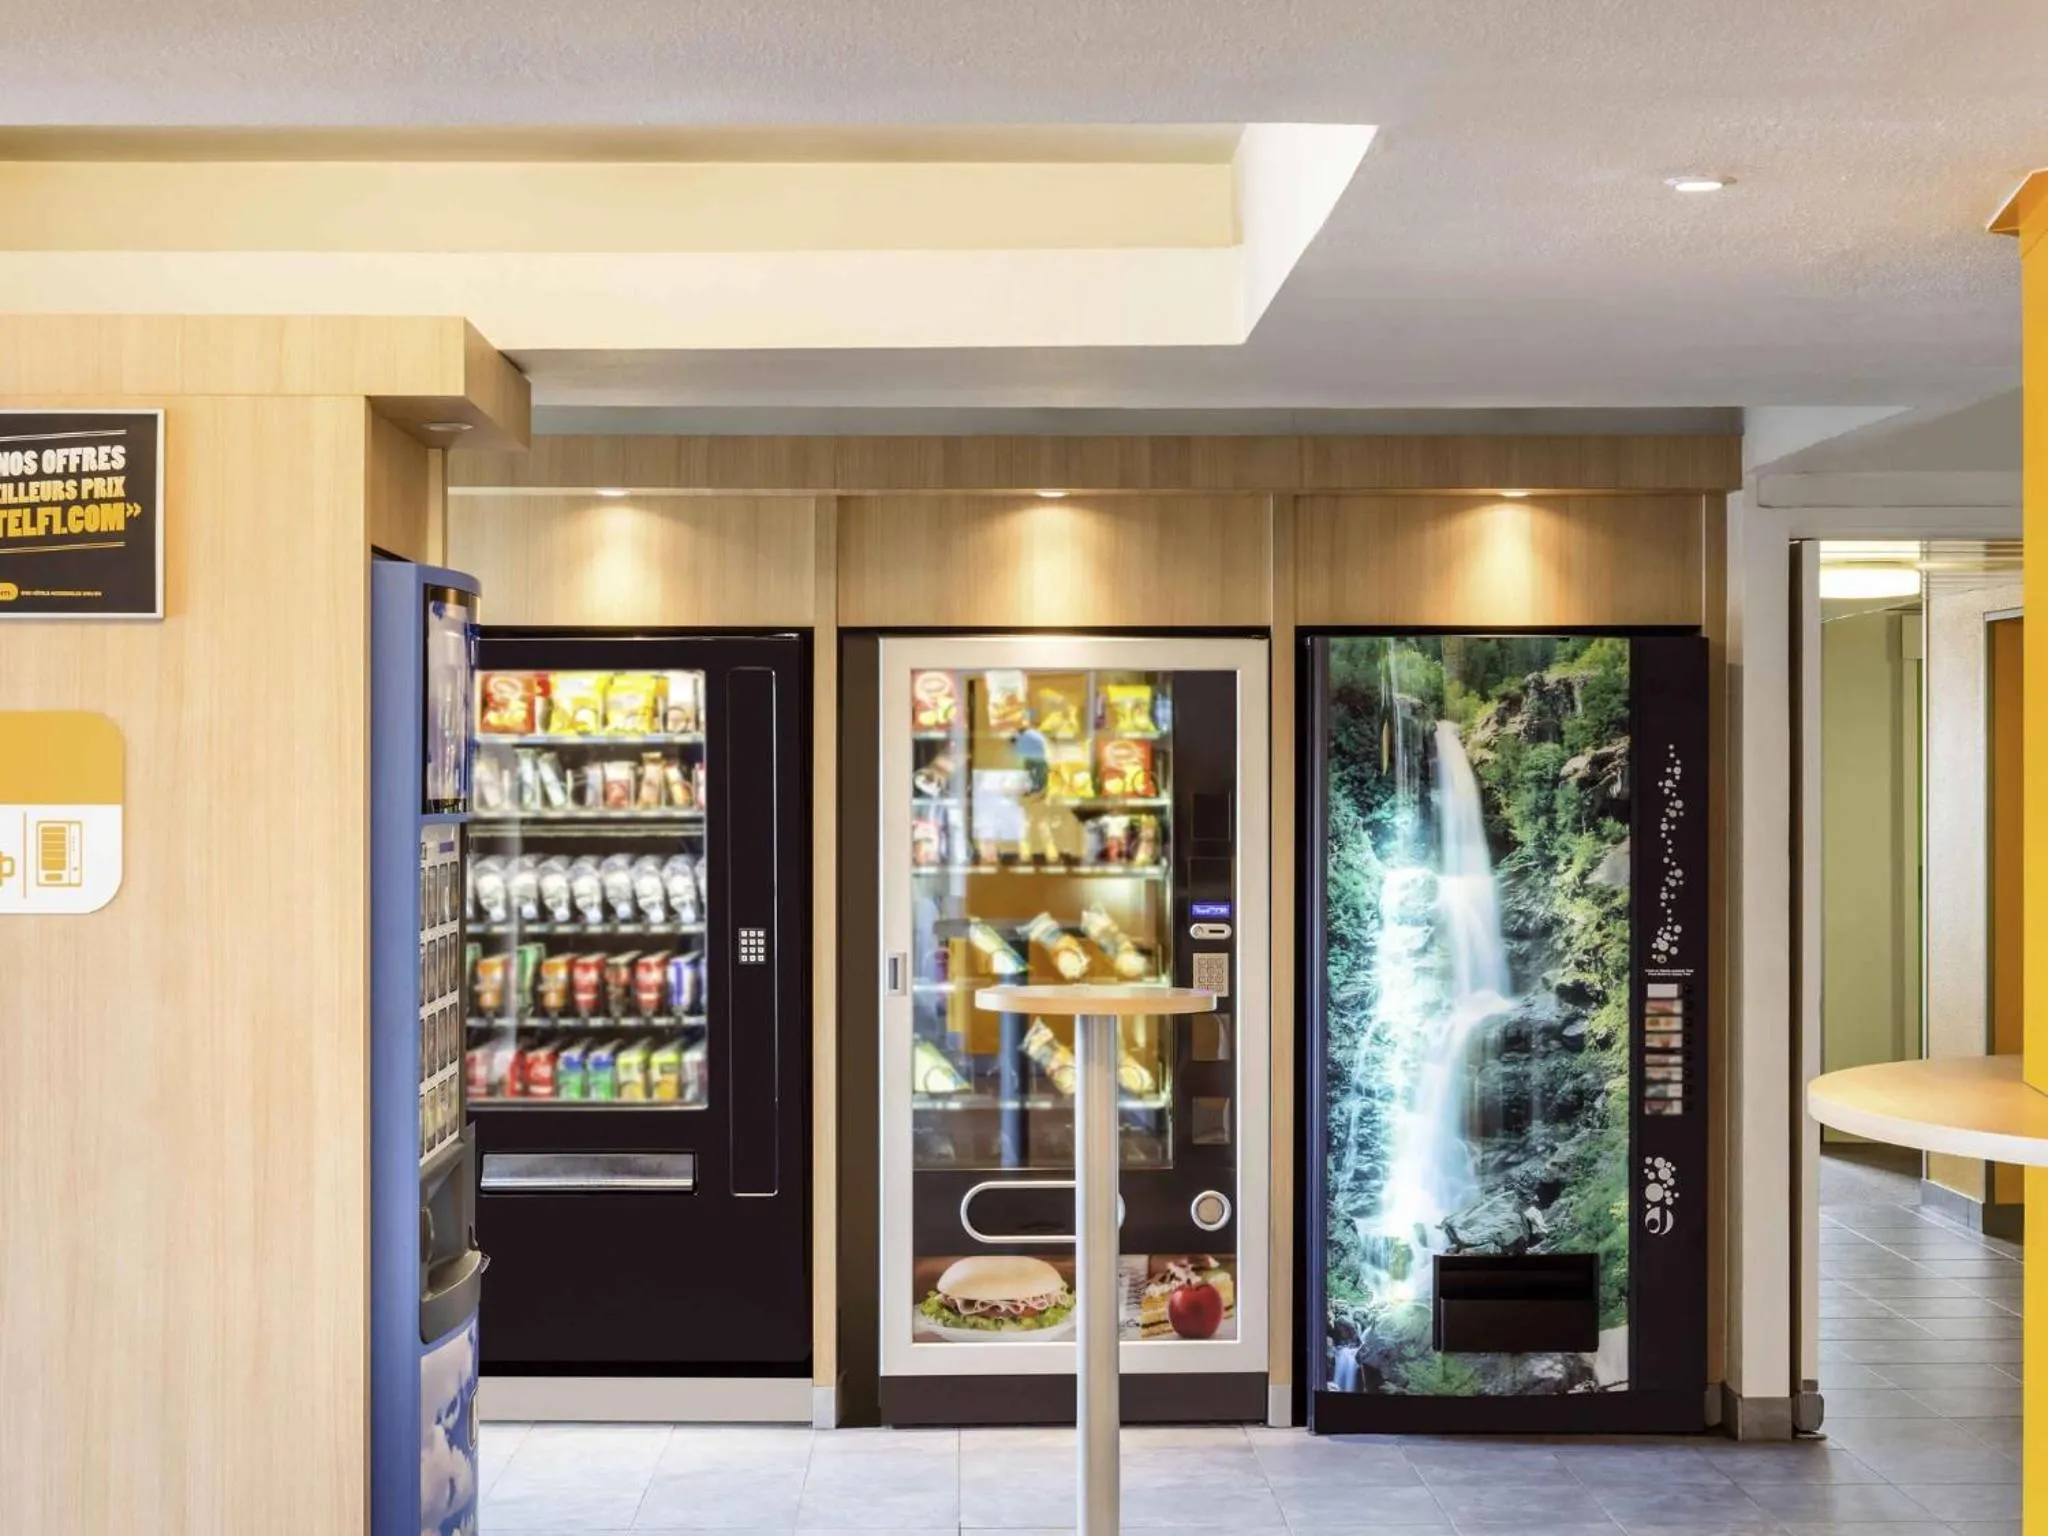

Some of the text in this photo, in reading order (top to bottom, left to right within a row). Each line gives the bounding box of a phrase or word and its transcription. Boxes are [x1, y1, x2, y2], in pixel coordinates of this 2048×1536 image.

[0, 445, 126, 476] NOS OFFRES
[0, 476, 126, 504] ILLEURS PRIX
